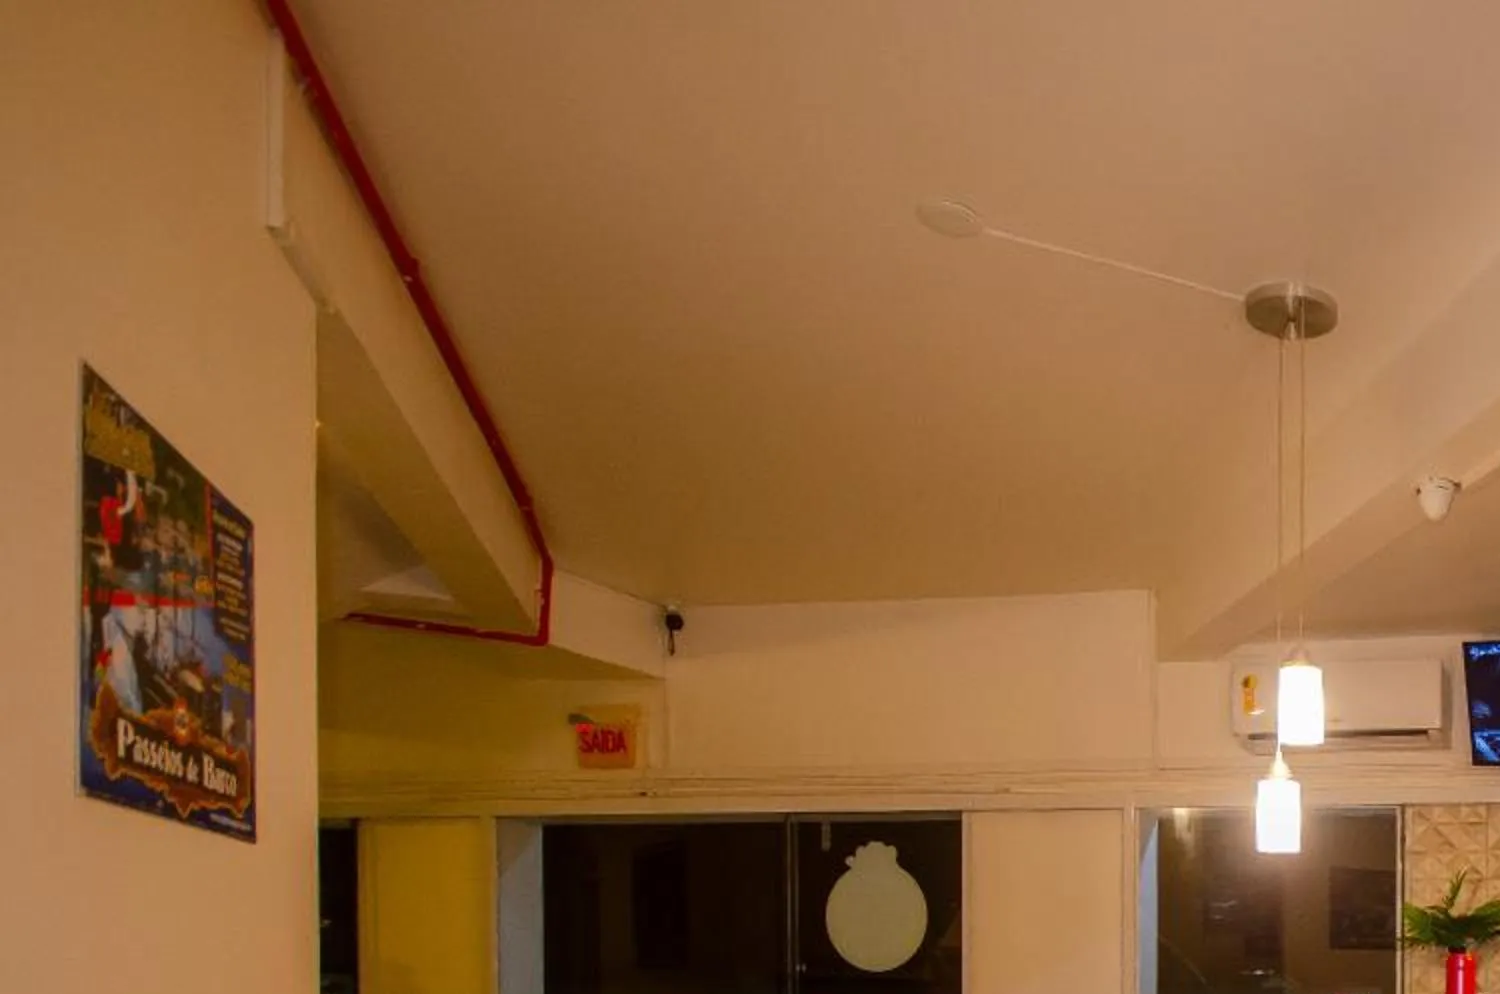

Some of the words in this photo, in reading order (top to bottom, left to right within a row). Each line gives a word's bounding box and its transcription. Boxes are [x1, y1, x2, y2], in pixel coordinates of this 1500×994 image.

[117, 717, 184, 778] Passeios
[186, 754, 199, 784] de
[202, 751, 237, 798] Barco
